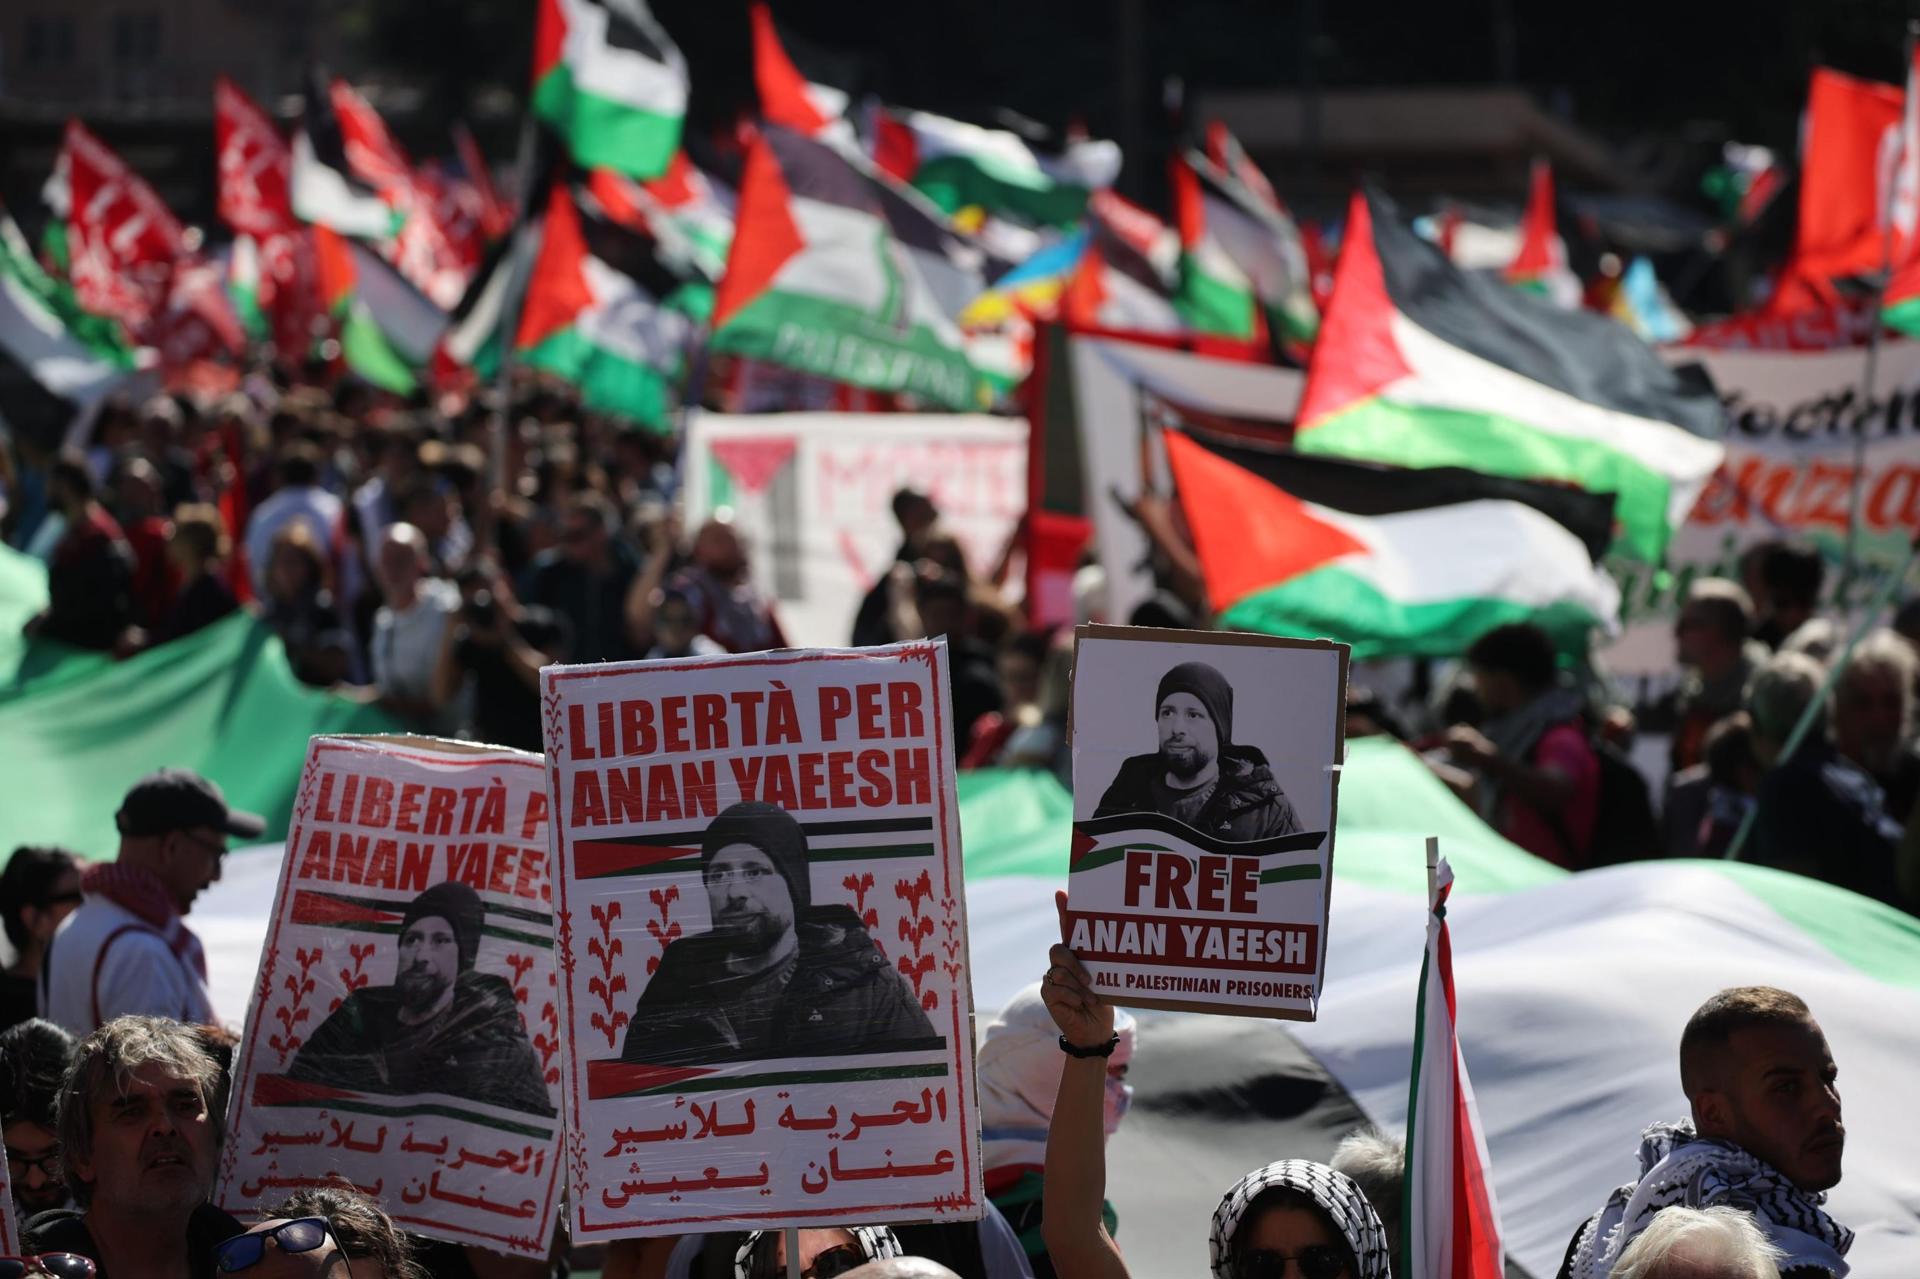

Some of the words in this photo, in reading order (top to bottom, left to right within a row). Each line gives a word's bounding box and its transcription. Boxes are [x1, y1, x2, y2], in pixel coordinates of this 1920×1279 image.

[568, 680, 802, 761] LIBERTÀ
[818, 682, 925, 741] PER
[314, 773, 507, 836] LIBERTÀ
[570, 760, 718, 828] ANAN
[729, 748, 932, 811] YAEESH
[298, 831, 434, 892] ANAN
[446, 842, 552, 904] YAEE
[1124, 849, 1261, 914] FREE
[1069, 918, 1167, 957] ANAN
[1179, 925, 1308, 965] YAEESH
[1096, 971, 1121, 988] ALL
[1126, 973, 1221, 995] PALESTINIAN
[777, 1086, 947, 1141] الحرية
[401, 1121, 545, 1177] الحرية
[800, 1146, 955, 1195] عنان
[401, 1170, 537, 1219] عنان
[601, 1161, 772, 1209] يعيش
